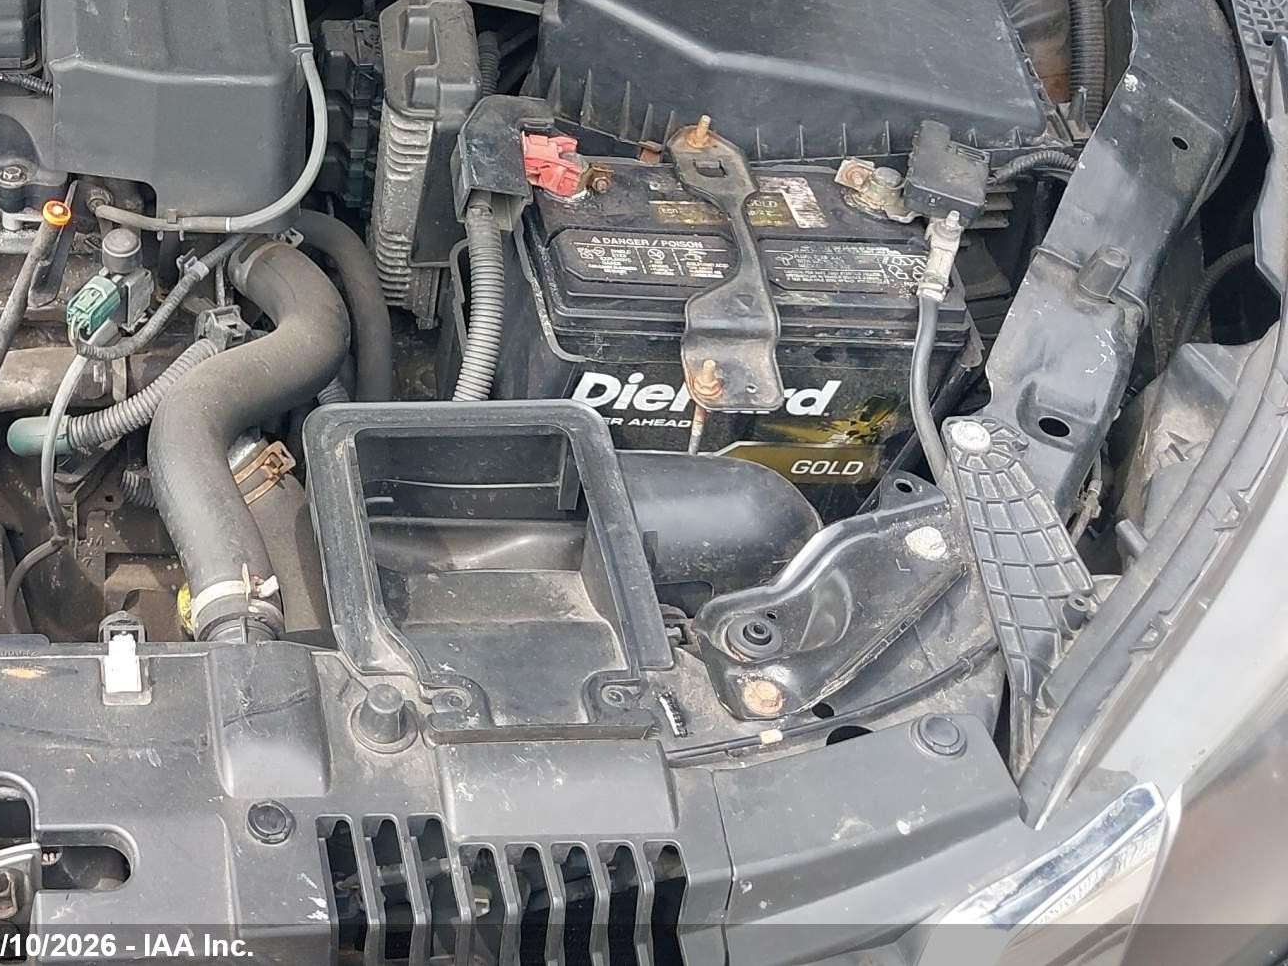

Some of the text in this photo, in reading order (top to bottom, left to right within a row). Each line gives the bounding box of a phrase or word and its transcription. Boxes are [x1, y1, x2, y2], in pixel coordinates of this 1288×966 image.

[601, 237, 650, 246] DANGER
[660, 240, 704, 248] POISON
[627, 418, 692, 428] AHEAD
[790, 460, 865, 477] GOLD
